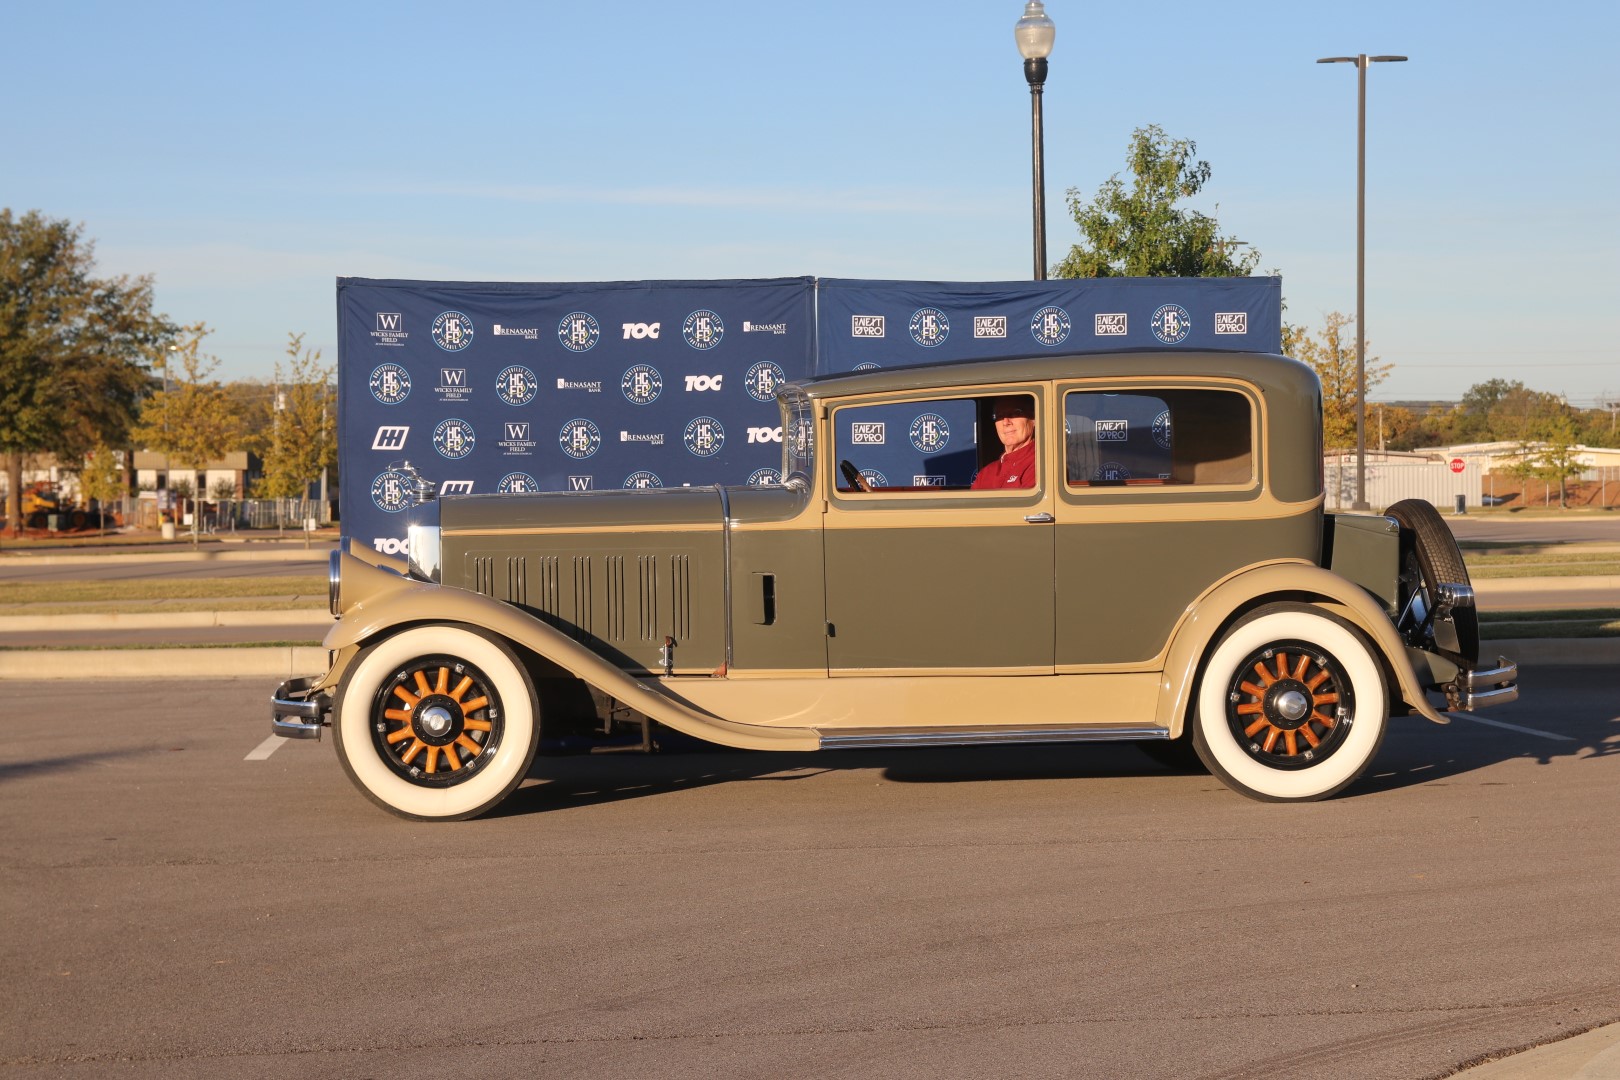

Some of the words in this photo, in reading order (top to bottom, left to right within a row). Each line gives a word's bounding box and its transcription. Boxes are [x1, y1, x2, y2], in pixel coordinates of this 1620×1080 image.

[379, 315, 399, 329] W
[697, 318, 710, 330] HC
[859, 317, 882, 326] NEXT
[923, 315, 936, 327] HC
[980, 319, 1003, 327] NEXT
[1044, 314, 1057, 326] HC
[1102, 316, 1124, 324] NEXT
[1164, 312, 1177, 324] HC
[1222, 315, 1244, 323] NEXT
[446, 319, 459, 332] HC
[572, 320, 585, 332] HC
[622, 323, 660, 339] TOC
[383, 371, 397, 384] HC
[443, 371, 463, 385] W
[510, 373, 523, 385] HC
[635, 372, 648, 384] HC
[759, 369, 772, 382] HC
[685, 375, 722, 391] TOC
[507, 425, 527, 439] W
[698, 424, 710, 437] HC
[859, 425, 882, 433] NEXT
[923, 421, 936, 433] HC
[1102, 422, 1125, 430] NEXT
[447, 426, 461, 439] HC
[573, 426, 586, 439] HC
[747, 427, 782, 443] TOC
[385, 480, 398, 492] HC
[571, 478, 590, 490] W
[374, 538, 409, 554] TOC
